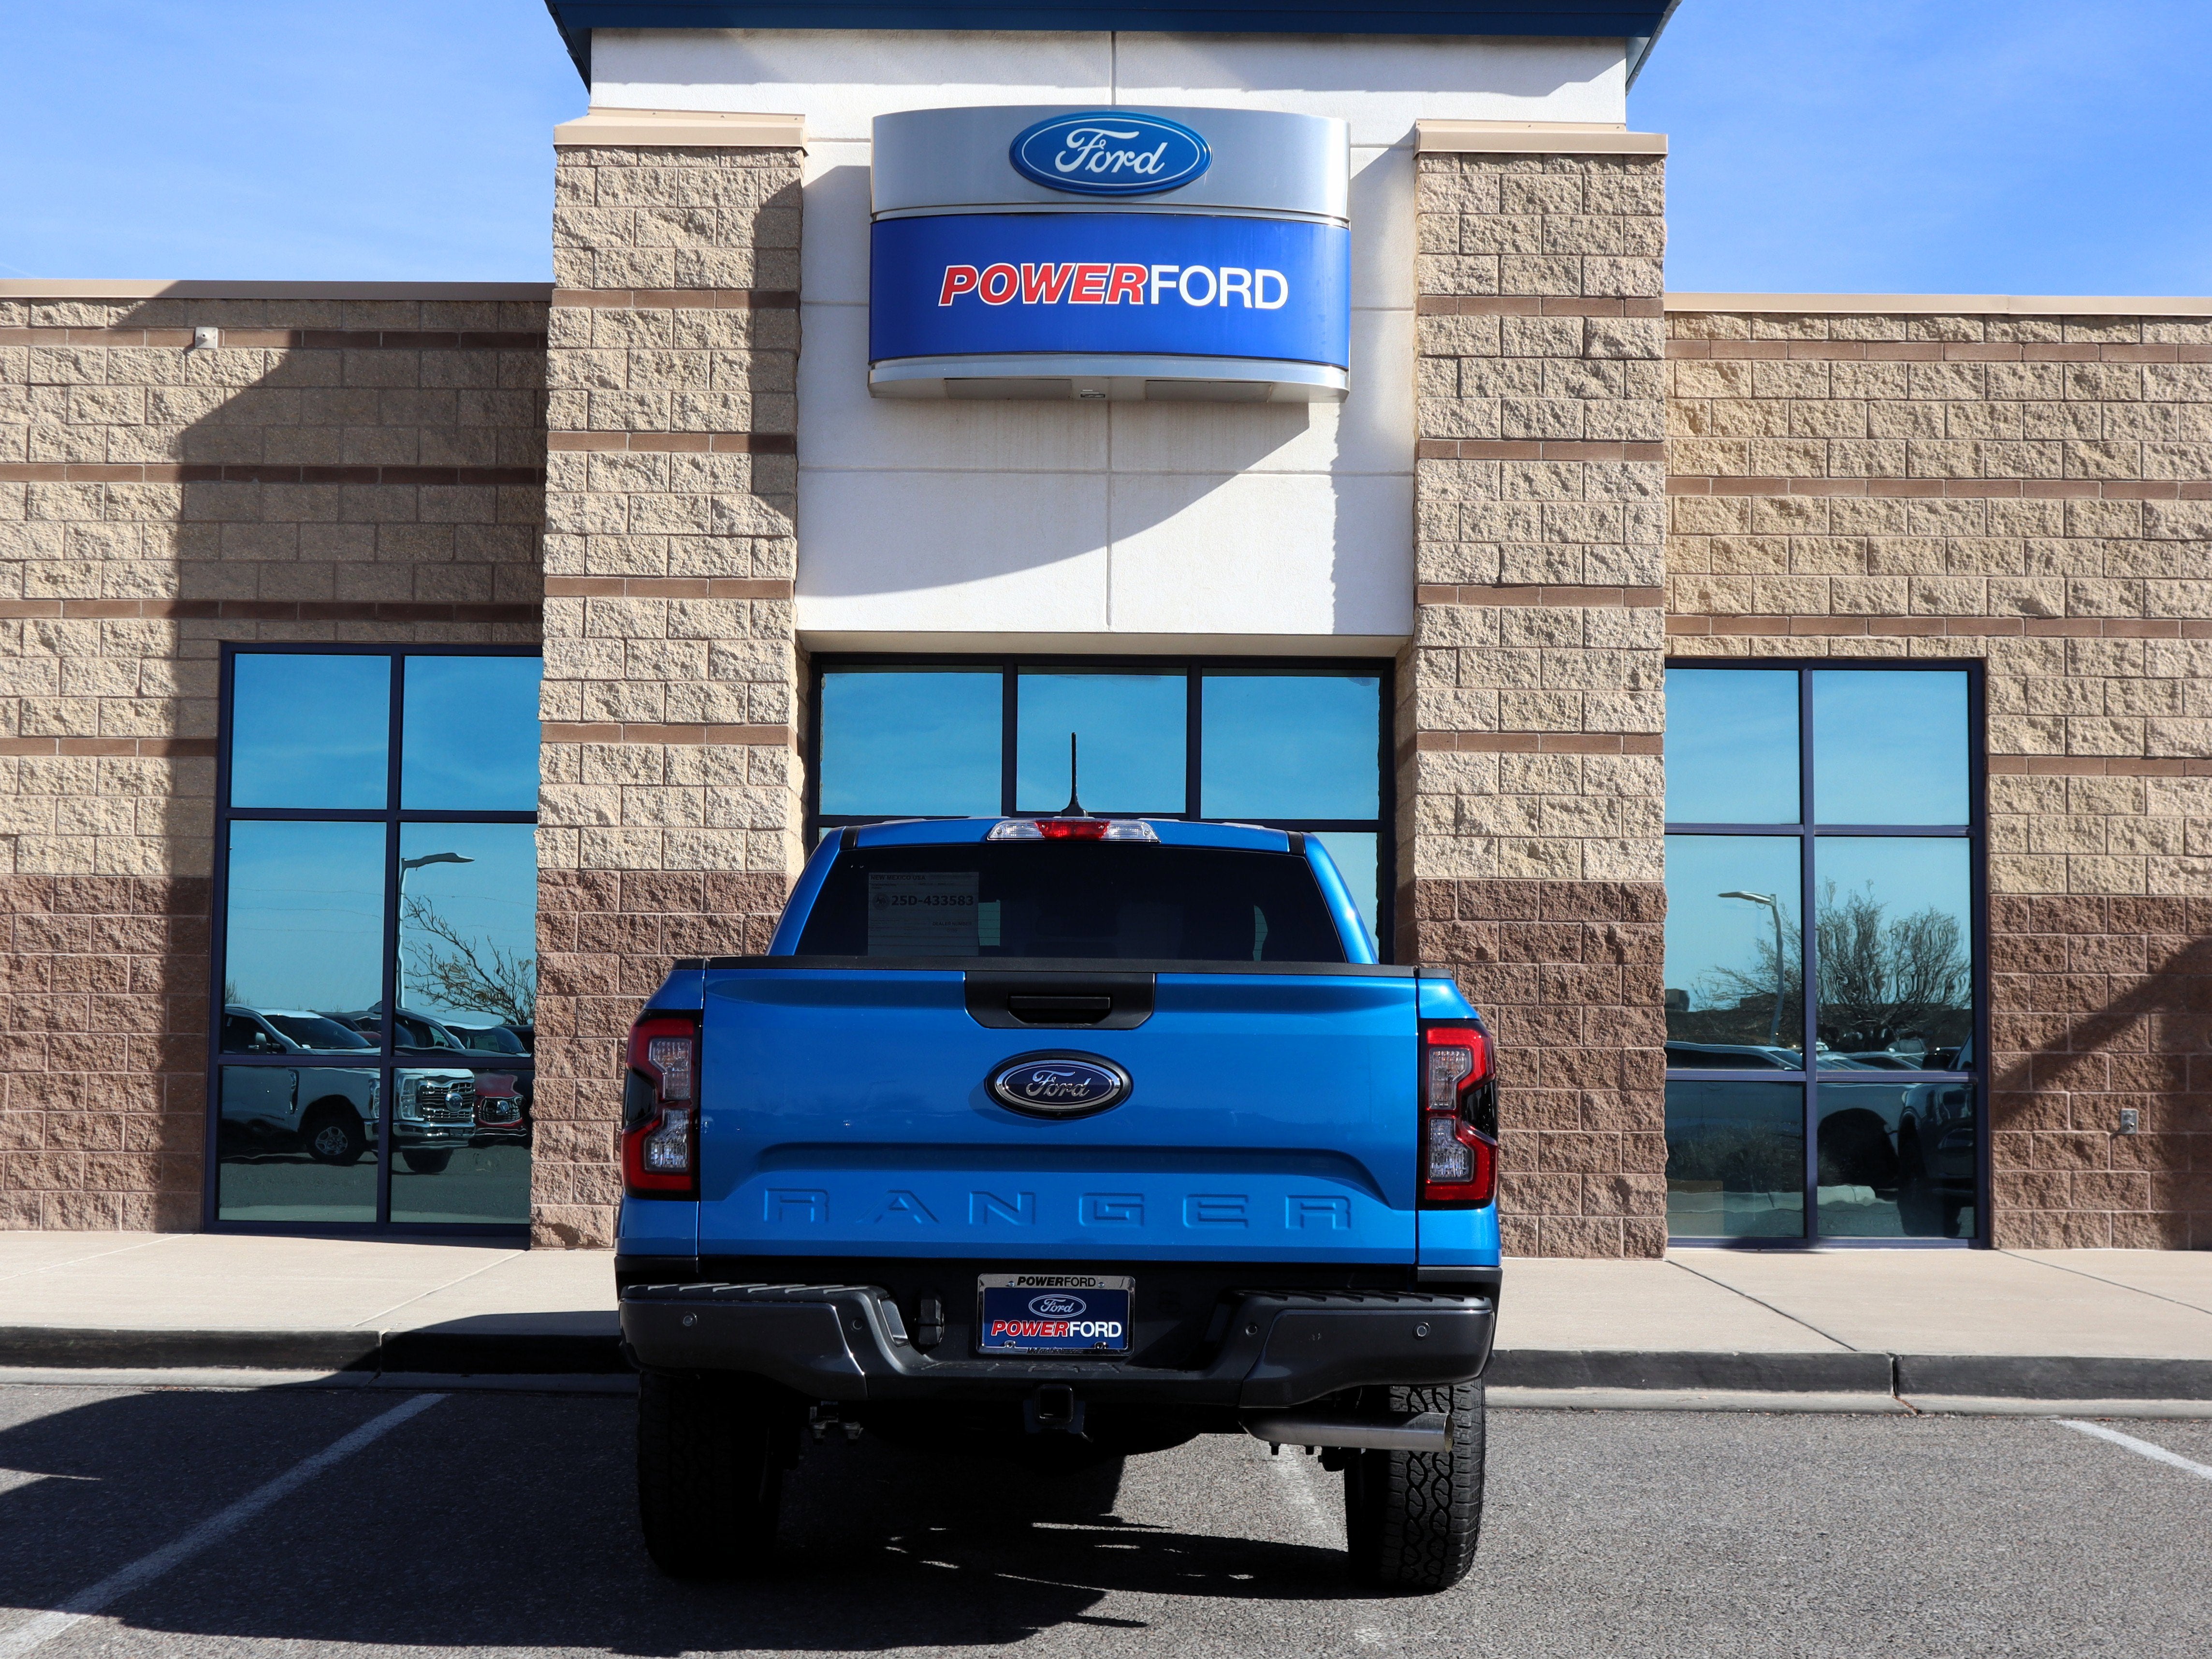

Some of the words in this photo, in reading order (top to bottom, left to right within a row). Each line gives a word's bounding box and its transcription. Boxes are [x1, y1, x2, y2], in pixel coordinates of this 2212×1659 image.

[1054, 127, 1168, 175] Ford
[937, 262, 1289, 310] POWERFORD
[891, 895, 974, 906] 25D-433583
[1025, 1070, 1091, 1097] Ford
[763, 1187, 1352, 1230] RANGER
[1017, 1276, 1096, 1287] POWERFORD
[1040, 1298, 1074, 1313] Ford
[990, 1320, 1122, 1338] POWERFORD
